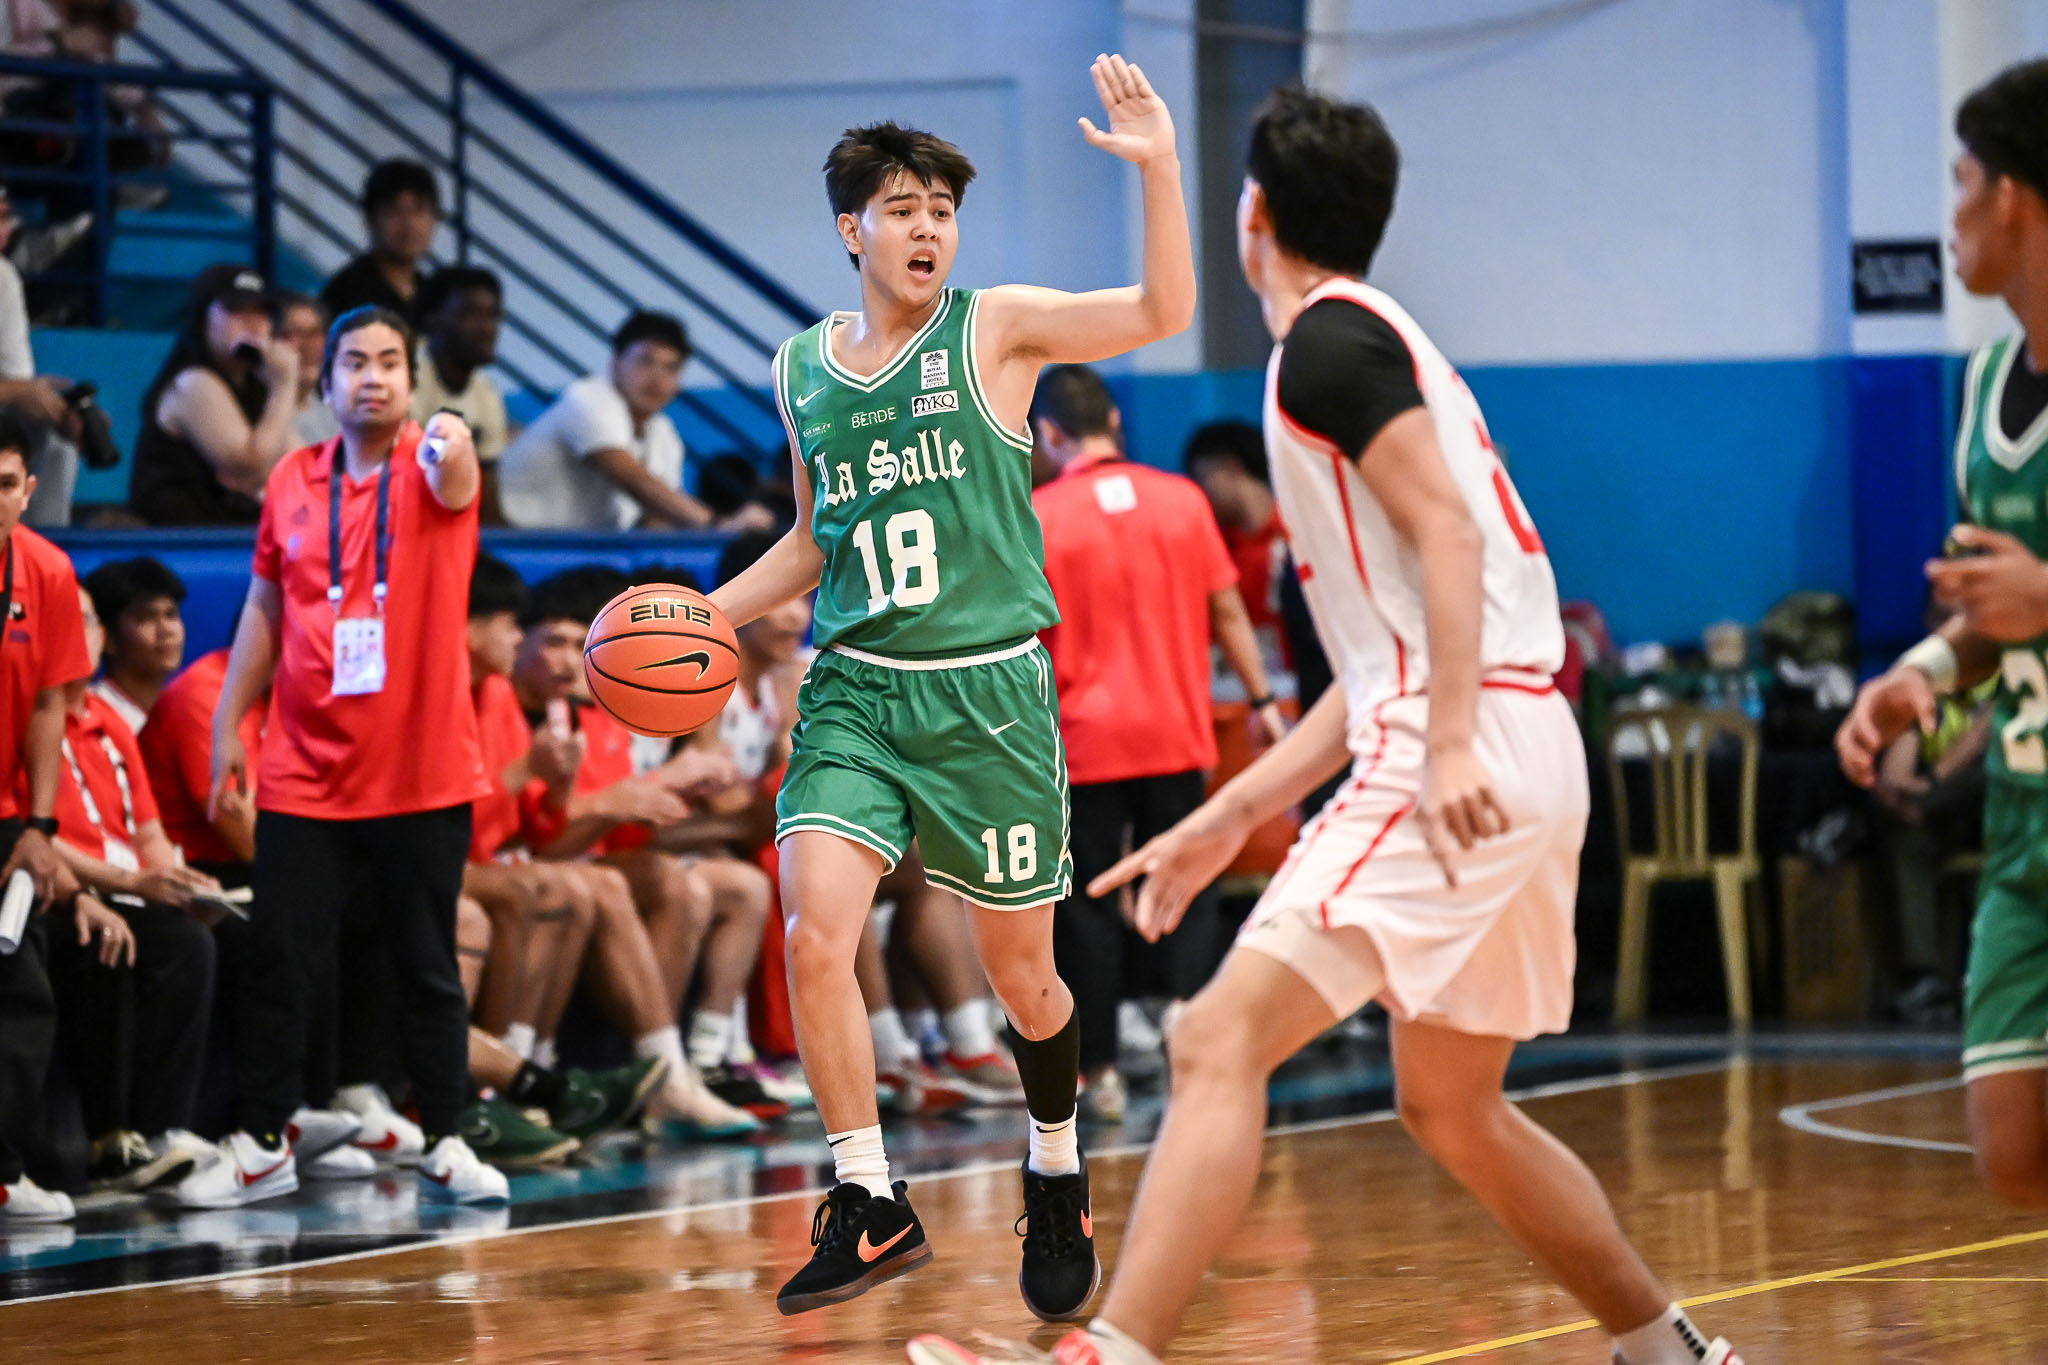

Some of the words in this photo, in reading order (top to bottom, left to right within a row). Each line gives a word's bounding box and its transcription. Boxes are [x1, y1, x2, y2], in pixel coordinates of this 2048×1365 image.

[851, 406, 897, 429] BERDE
[815, 452, 858, 509] La
[866, 426, 967, 496] Salle
[852, 508, 941, 617] 18
[2001, 648, 2048, 774] 2
[981, 822, 1037, 884] 18
